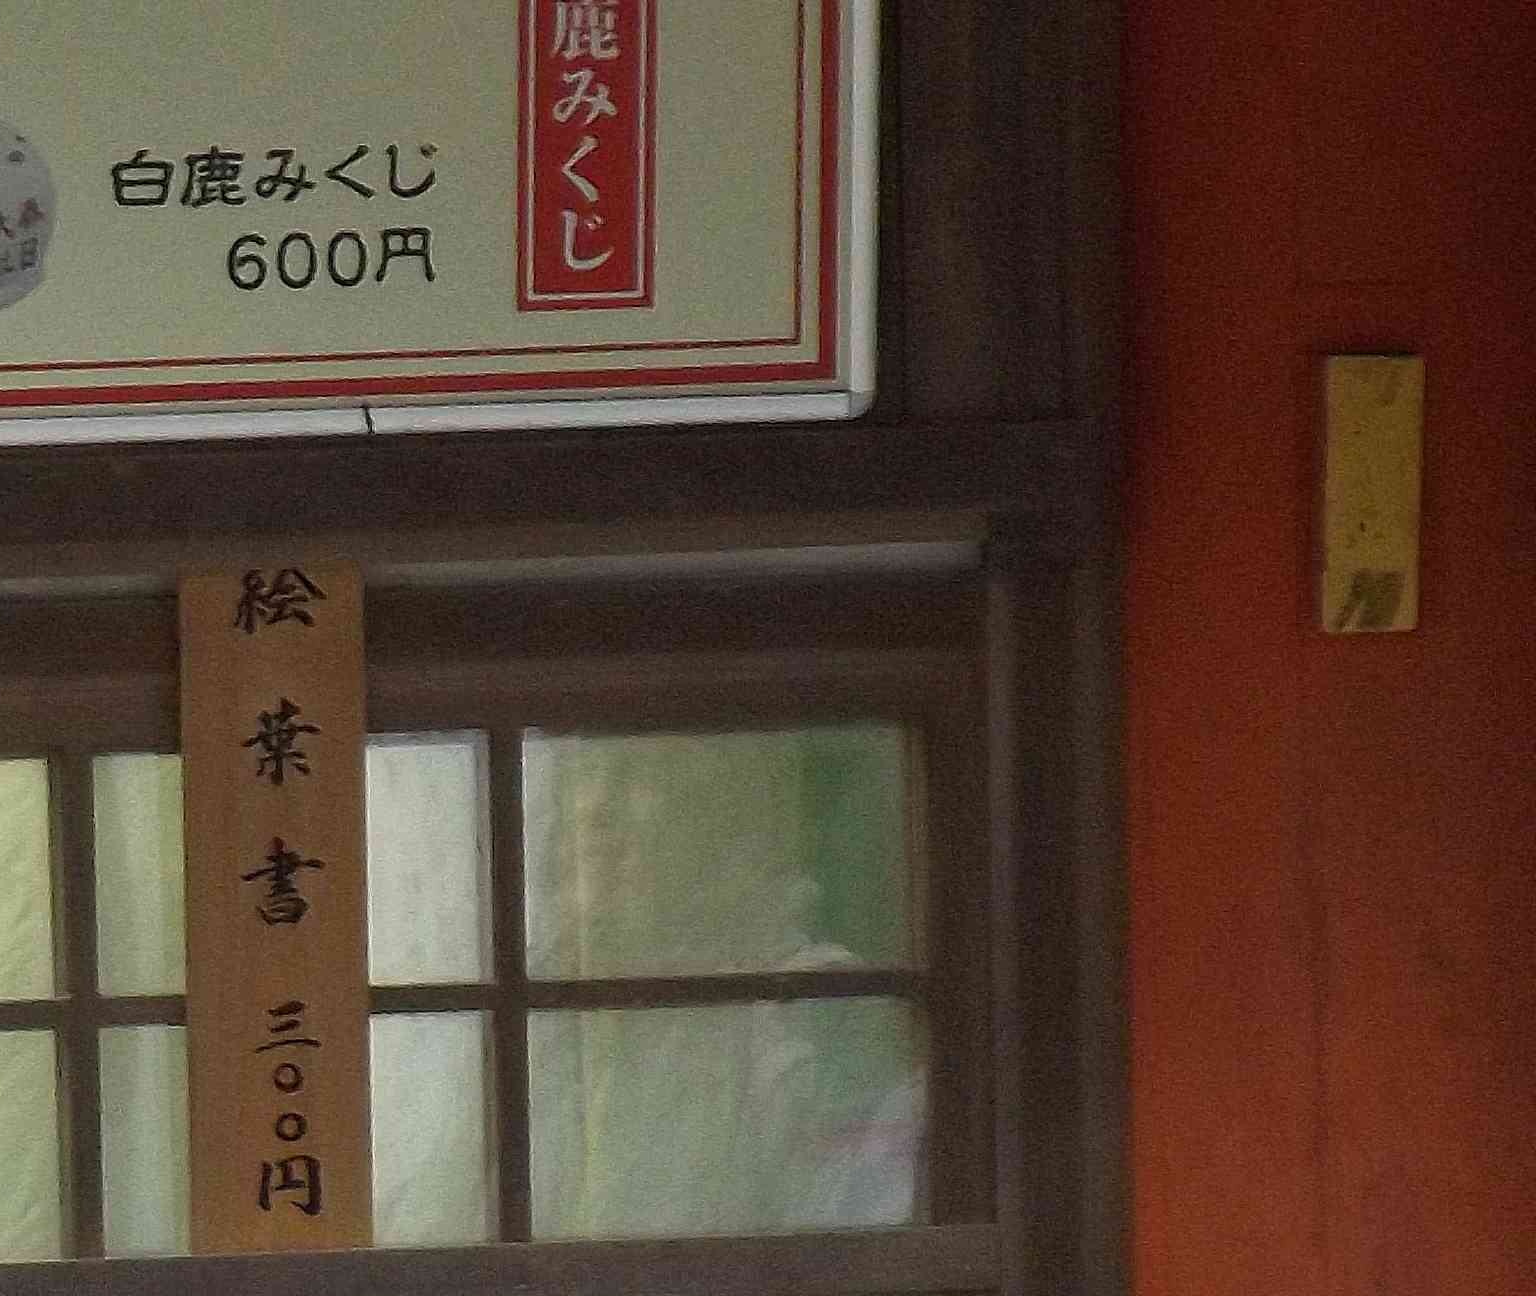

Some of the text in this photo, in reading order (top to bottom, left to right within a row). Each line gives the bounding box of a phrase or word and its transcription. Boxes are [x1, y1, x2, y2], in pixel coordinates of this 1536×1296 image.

[112, 144, 438, 208] 白鹿みくじ
[228, 226, 435, 291] 600円
[232, 567, 327, 927] 絵葉書
